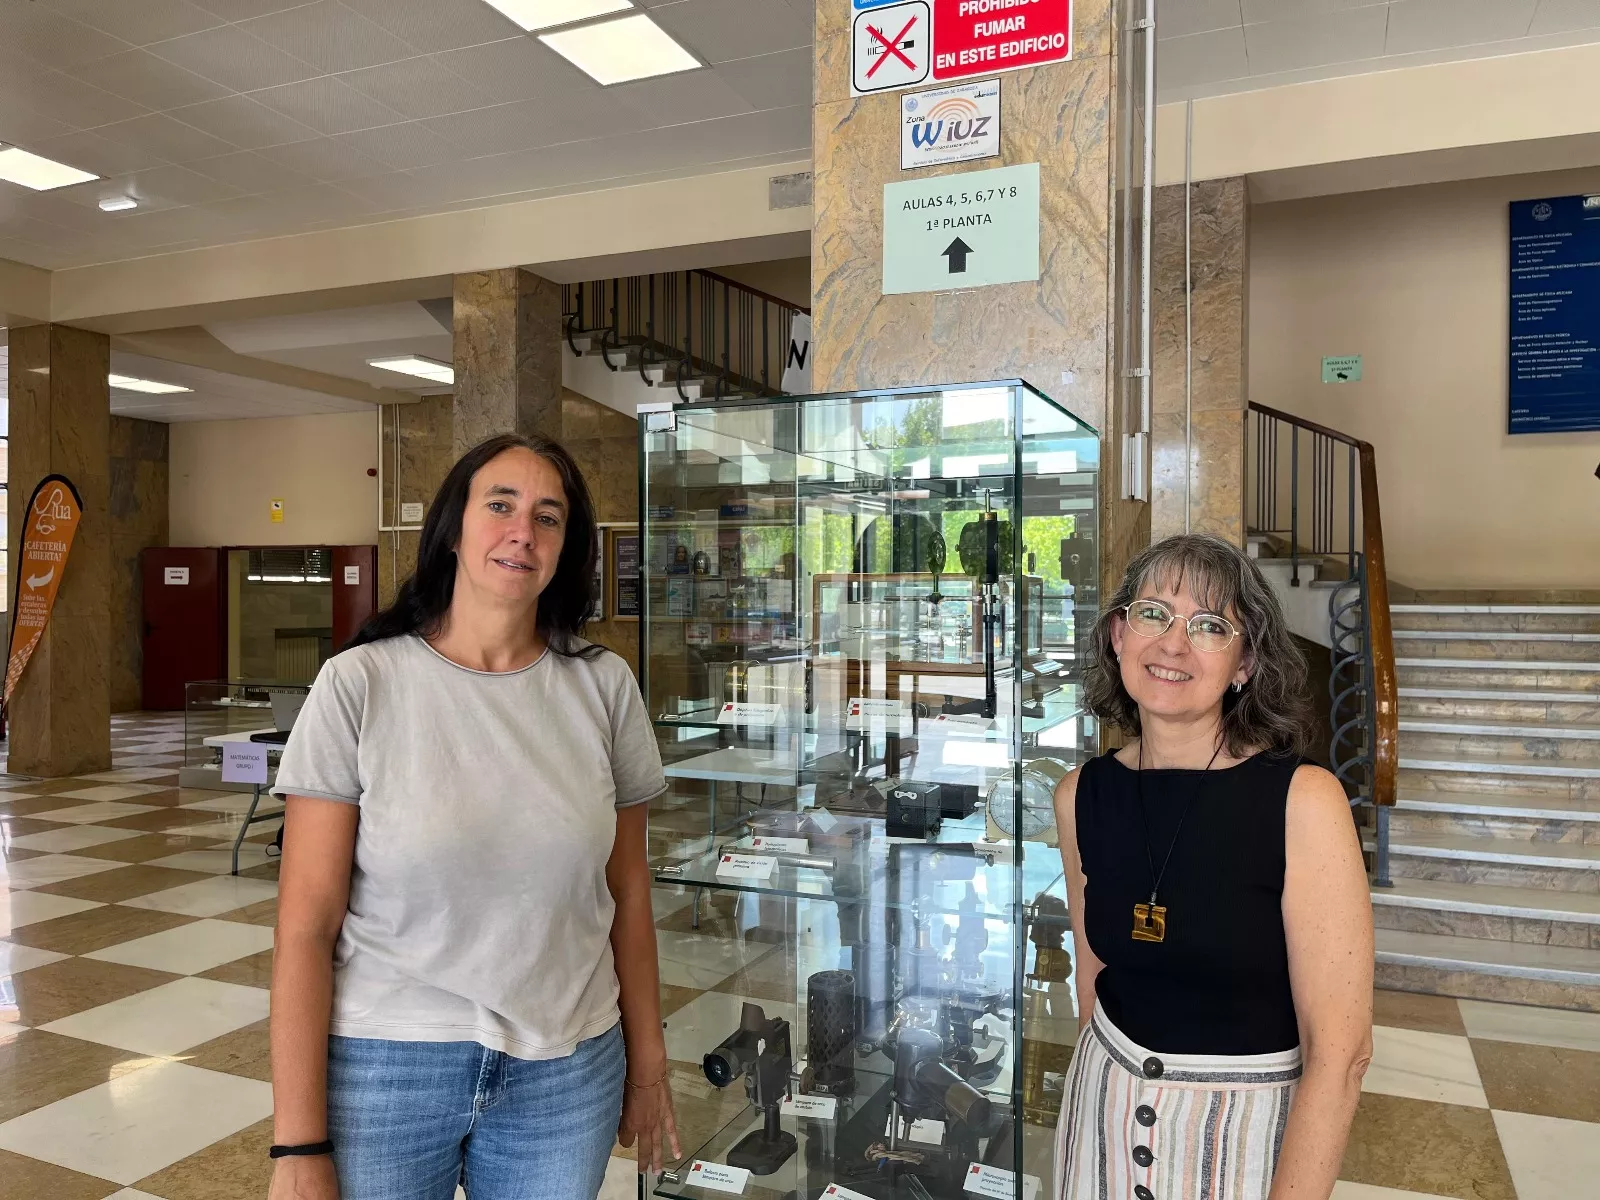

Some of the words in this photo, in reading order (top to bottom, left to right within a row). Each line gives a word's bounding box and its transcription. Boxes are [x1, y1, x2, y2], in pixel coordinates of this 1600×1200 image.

[974, 16, 1026, 38] FUMAR
[936, 53, 956, 69] EN
[960, 45, 996, 65] ESTE
[1000, 32, 1065, 58] EDIFICIO
[906, 116, 925, 124] Zona
[902, 196, 943, 211] AULAS
[945, 194, 957, 207] 4,
[960, 193, 972, 204] 5,
[998, 188, 1006, 198] Y
[1009, 186, 1017, 197] 8
[926, 219, 939, 231] 1ª
[943, 213, 992, 229] PLANTA
